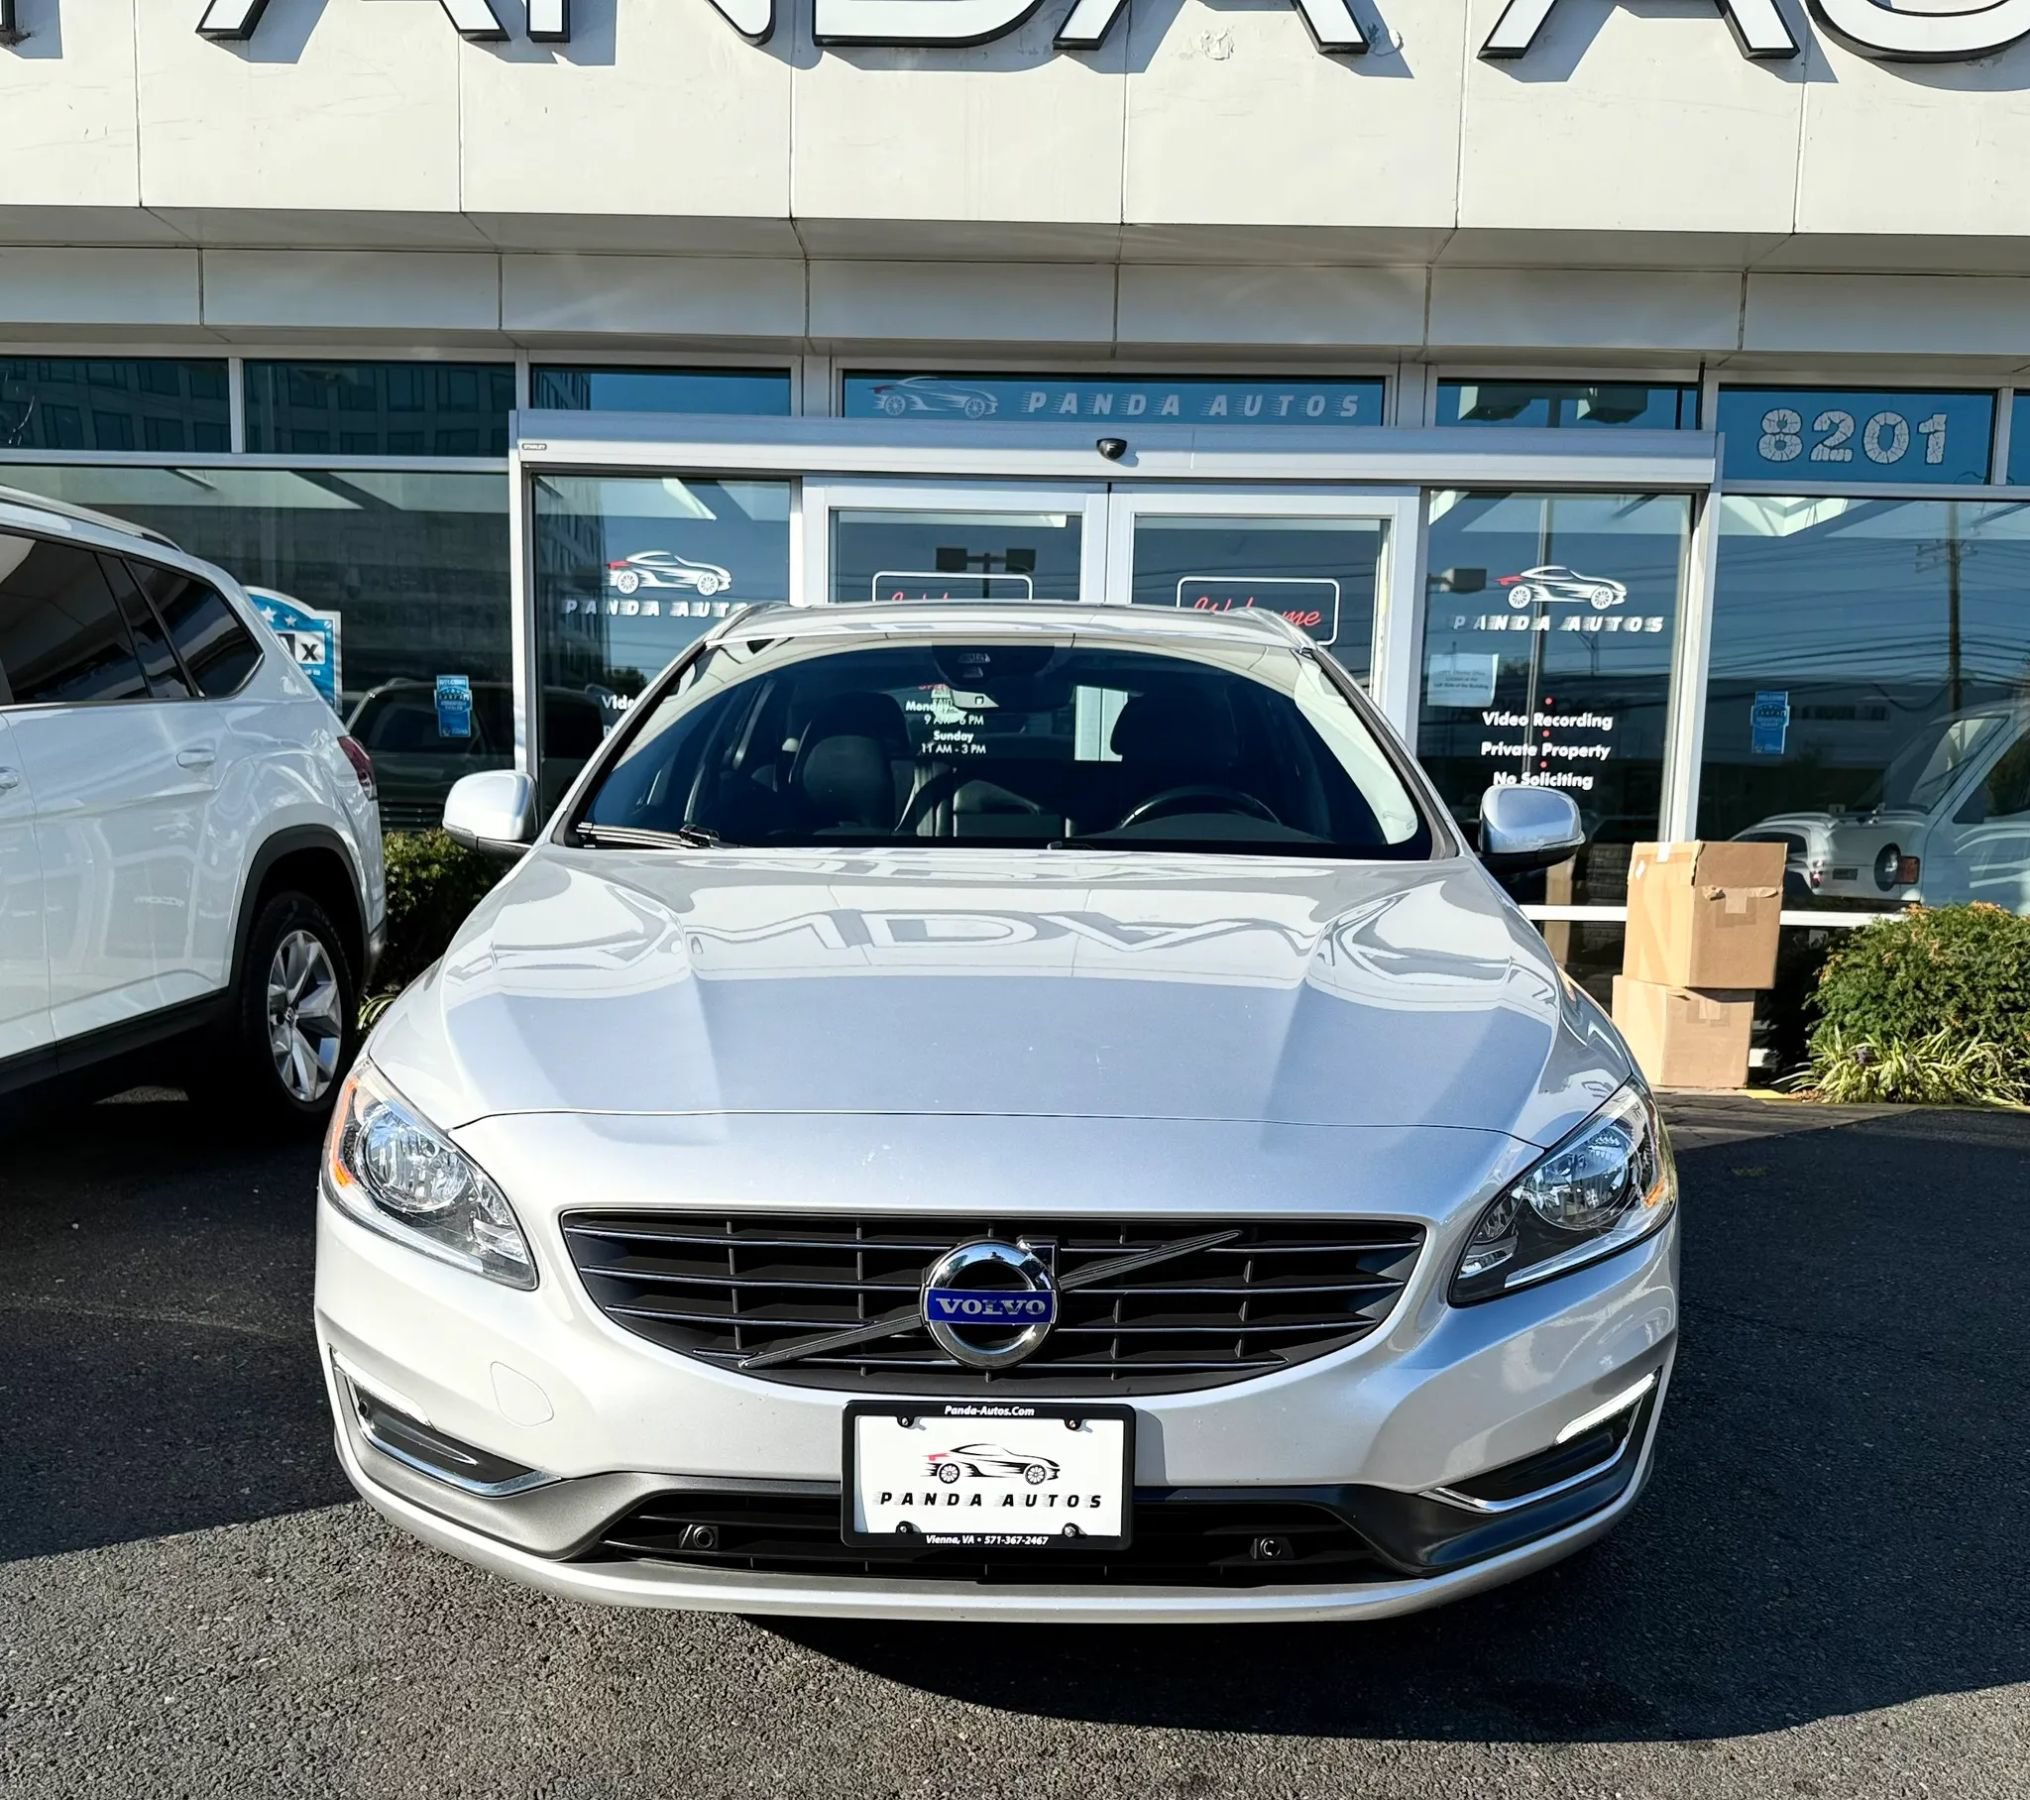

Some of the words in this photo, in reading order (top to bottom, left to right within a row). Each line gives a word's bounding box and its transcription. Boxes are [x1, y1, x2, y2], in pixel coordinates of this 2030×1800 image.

[1024, 391, 1180, 417] PANDA
[1206, 394, 1360, 417] AUTOS
[1757, 408, 1948, 465] 8201
[566, 599, 660, 617] PANDA
[675, 601, 747, 618] AUT
[1453, 614, 1550, 631] PANDA
[1562, 615, 1665, 633] AUTOS
[924, 713, 932, 725] 9
[968, 714, 984, 726] PM
[1482, 711, 1529, 727] Video
[1533, 712, 1613, 731] Recording
[933, 730, 974, 743] Sunday
[935, 743, 953, 754] AM
[961, 743, 969, 755] 3
[970, 744, 987, 754] PM
[1481, 741, 1538, 757] Private
[1541, 742, 1611, 761] Property
[1493, 771, 1518, 786] No
[1520, 771, 1594, 791] Soliciting
[935, 1297, 1046, 1316] VOLVO
[944, 1405, 1035, 1417] Panda-Autos.Com
[879, 1491, 983, 1507] PANDA
[1001, 1493, 1102, 1509] AUTOS
[925, 1534, 960, 1545] Vienna,
[961, 1535, 975, 1545] VA
[983, 1535, 1049, 1546] 571-367-2467
